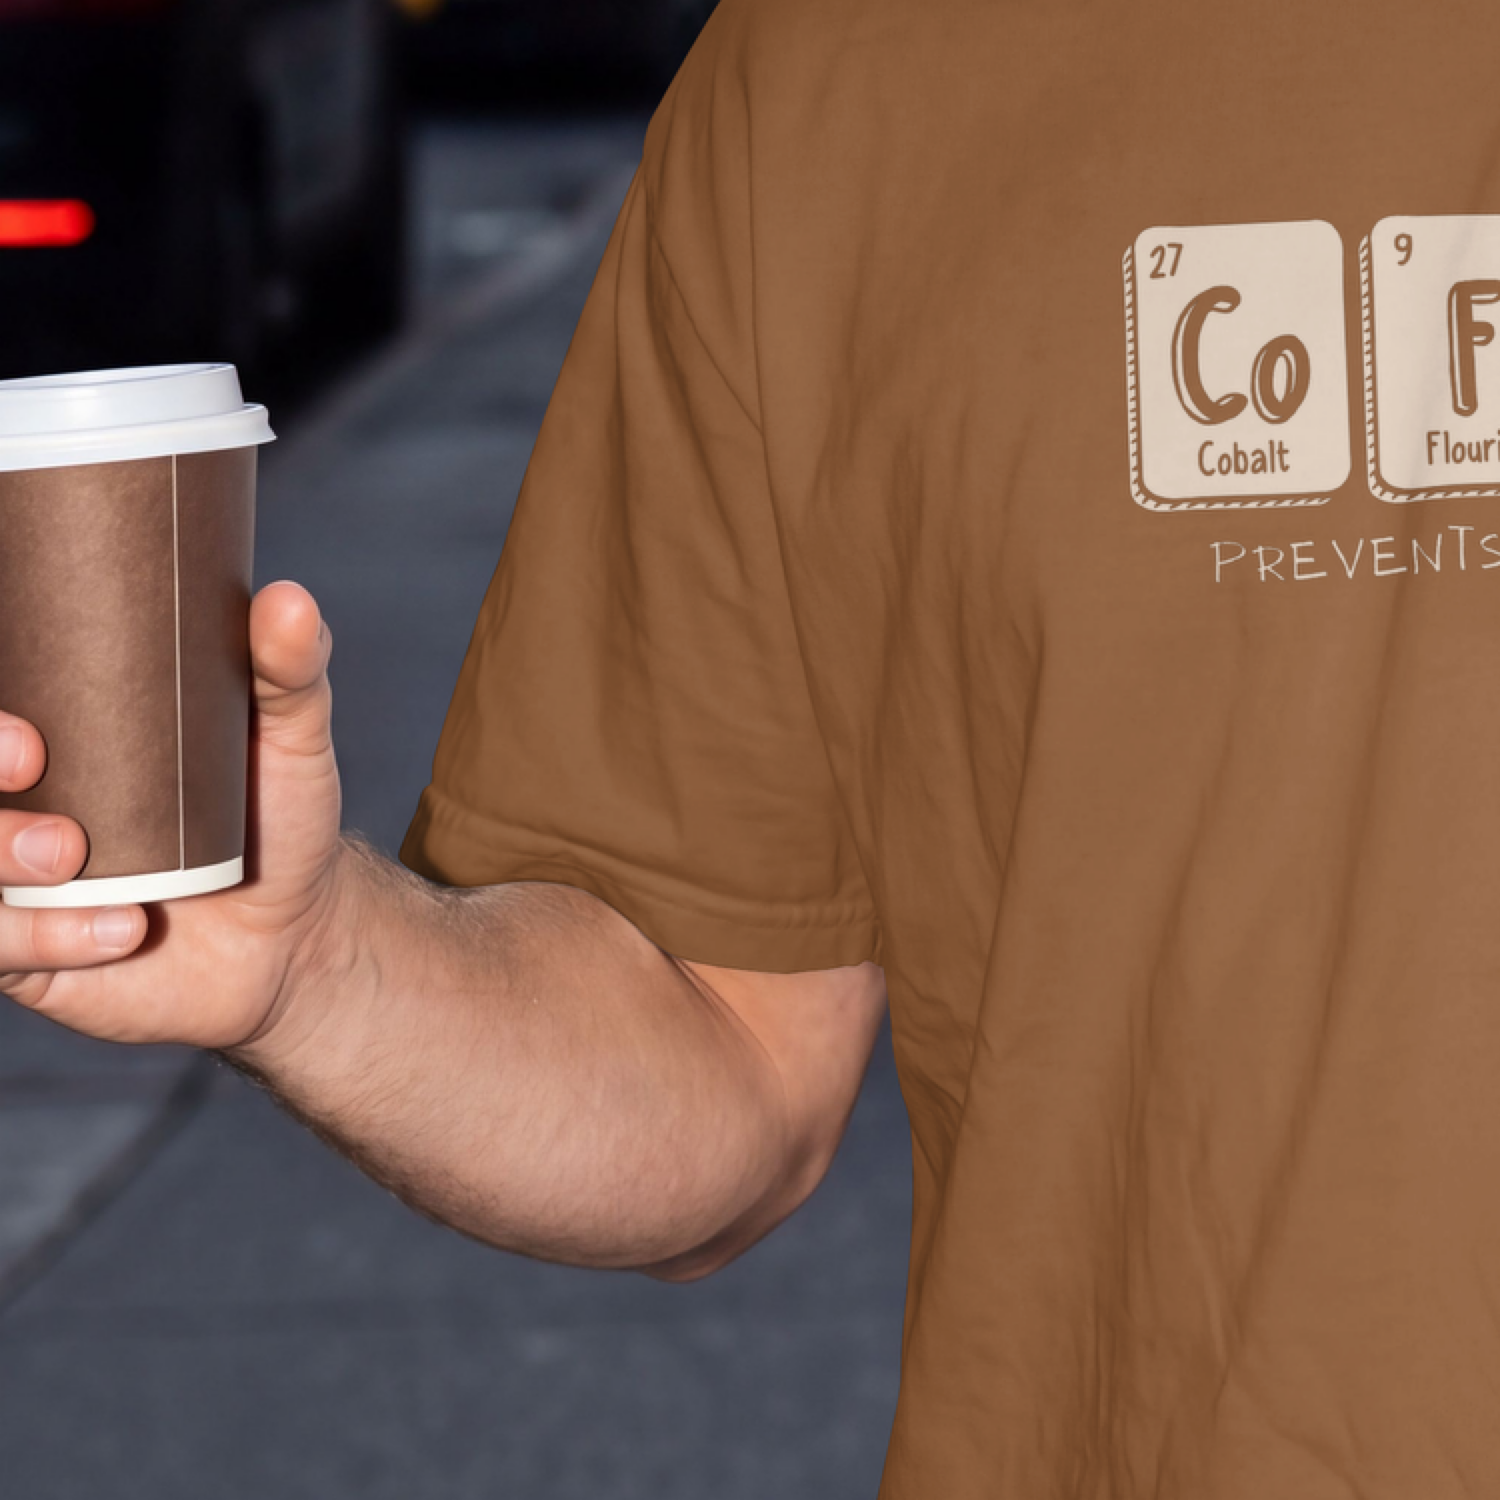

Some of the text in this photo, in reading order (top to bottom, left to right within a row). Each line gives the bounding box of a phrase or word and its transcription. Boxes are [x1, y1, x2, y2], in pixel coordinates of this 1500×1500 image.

[1149, 242, 1184, 279] 27
[1393, 233, 1414, 266] 9
[1170, 284, 1312, 426] Co
[1197, 439, 1291, 477] Cobalt
